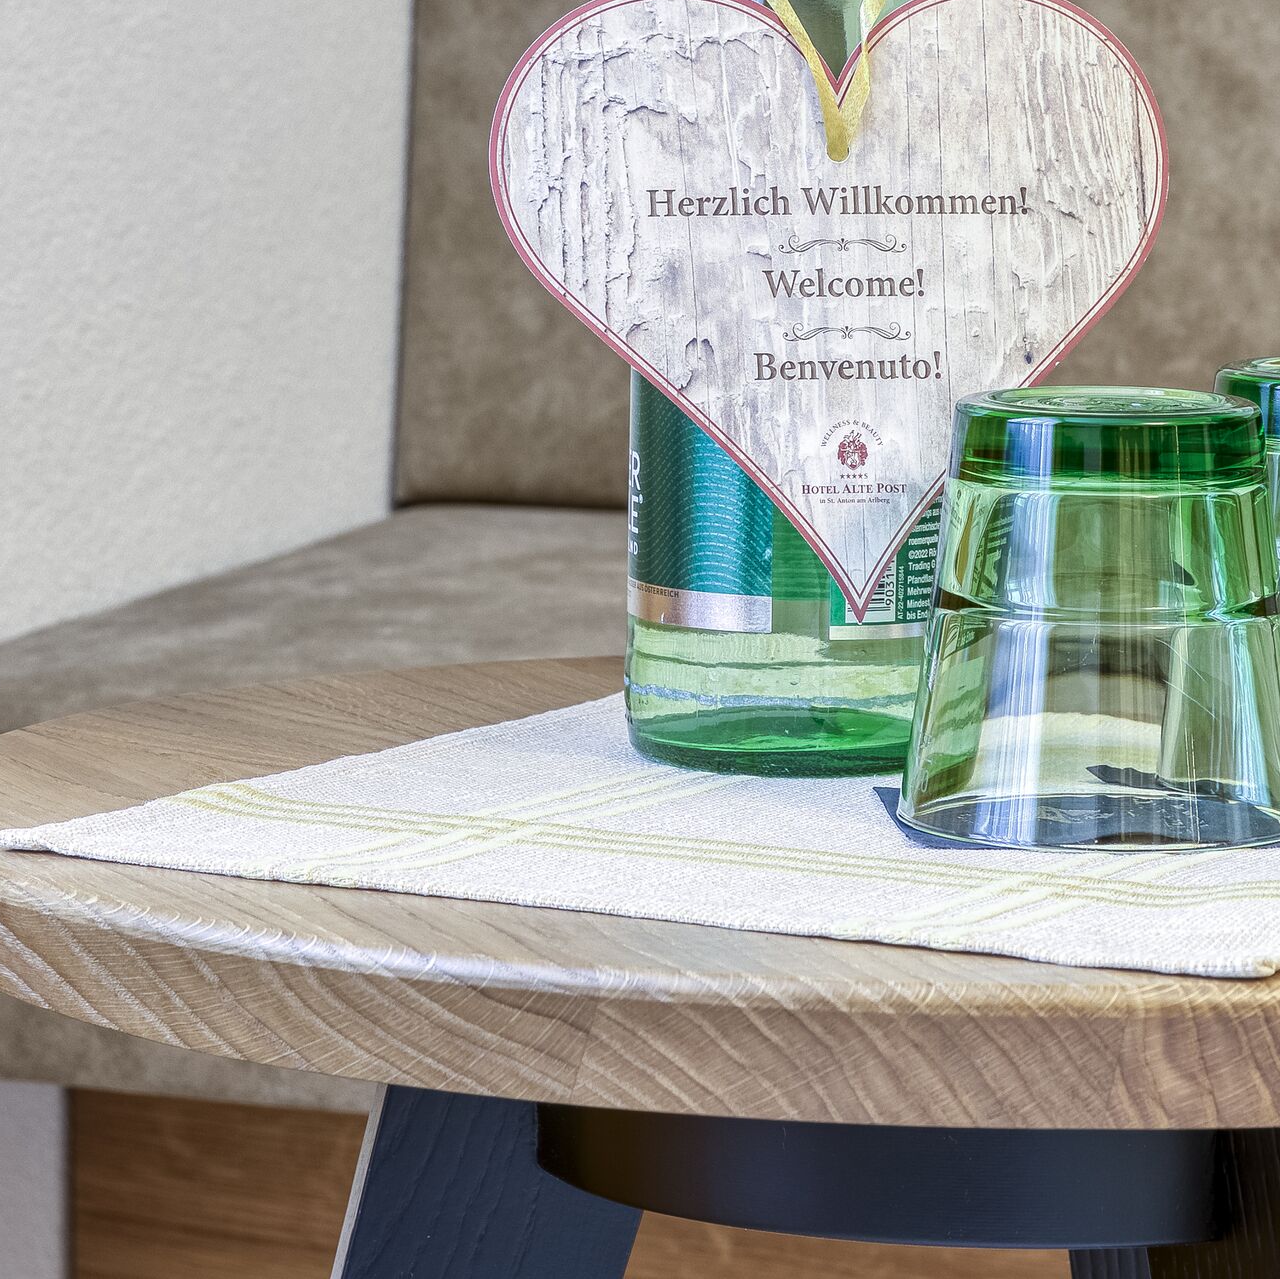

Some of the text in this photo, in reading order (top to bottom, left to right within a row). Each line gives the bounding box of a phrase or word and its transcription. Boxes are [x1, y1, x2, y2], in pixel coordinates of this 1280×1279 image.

[646, 186, 1029, 218] Herzlich Willkommen!
[762, 268, 925, 298] Welcome!
[753, 351, 942, 382] Benvenuto!
[820, 419, 851, 447] WELLNESS
[861, 422, 884, 446] BEAUTY
[802, 482, 908, 495] HOTEL ALTE POST
[867, 496, 891, 505] Arlberg
[908, 560, 931, 571] Trading
